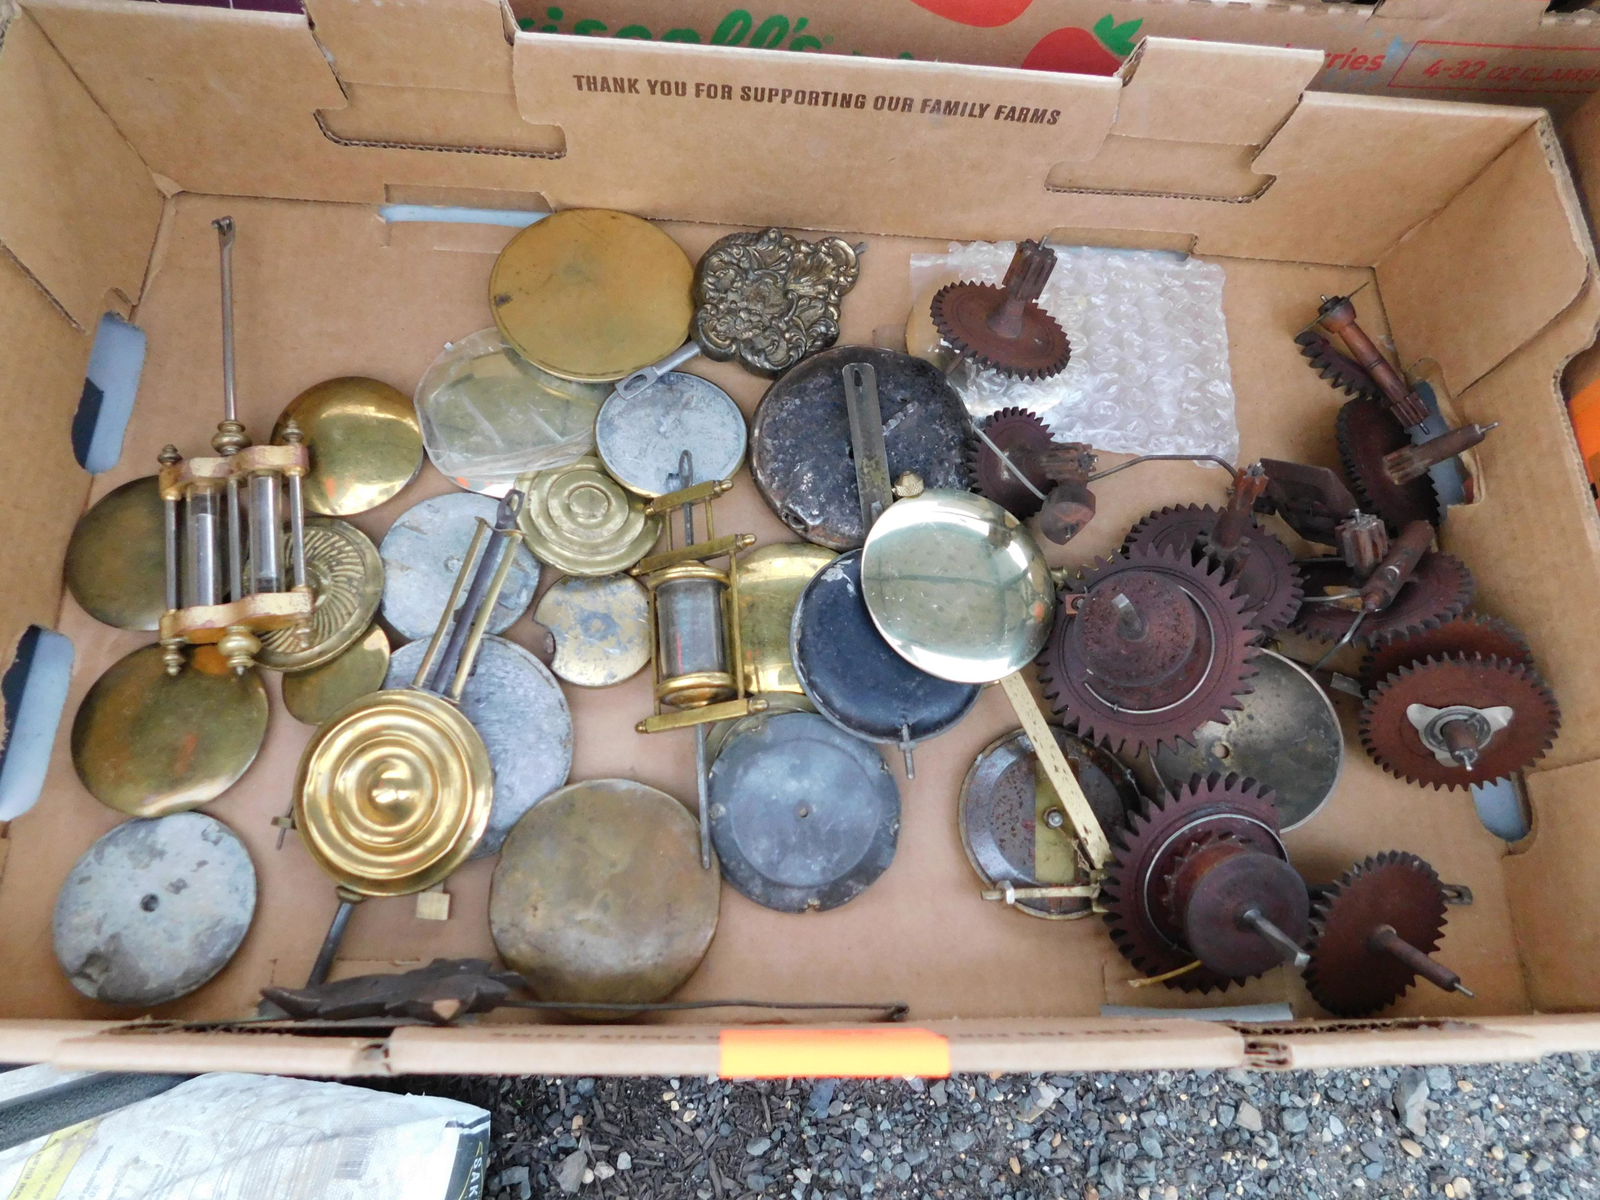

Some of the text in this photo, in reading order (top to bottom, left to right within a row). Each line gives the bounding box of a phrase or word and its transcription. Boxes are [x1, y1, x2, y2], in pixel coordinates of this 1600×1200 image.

[1325, 47, 1386, 71] ries
[1424, 59, 1488, 79] 4-32
[572, 75, 1062, 126] THANK YOU FOR SUPPORTING OUR FAMILY FARMS
